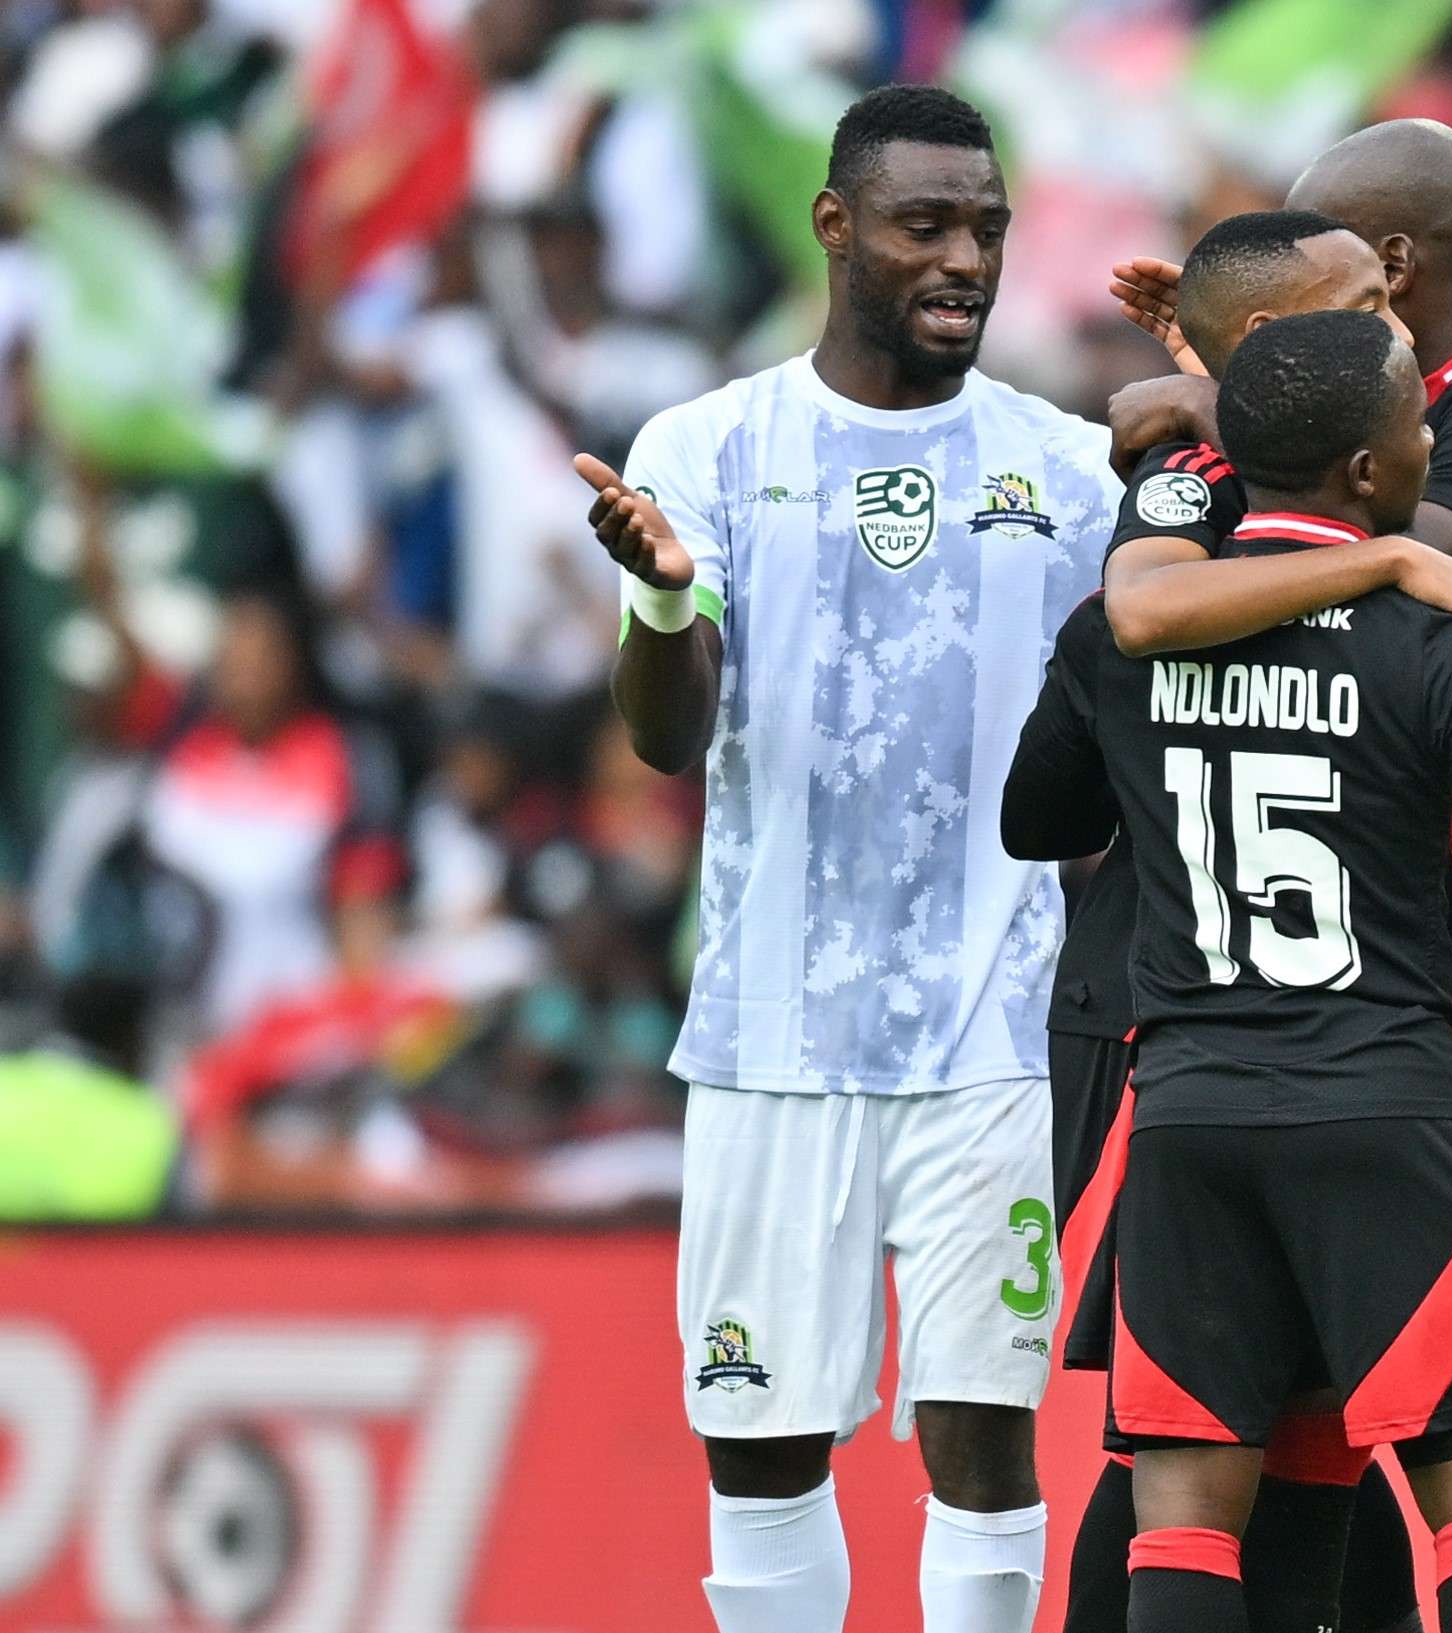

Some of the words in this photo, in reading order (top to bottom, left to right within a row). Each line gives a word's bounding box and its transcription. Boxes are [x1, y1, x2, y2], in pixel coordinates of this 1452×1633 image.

[866, 522, 926, 533] NEDBANK
[875, 534, 917, 551] CUP
[1151, 660, 1359, 737] NDLONDLO
[1165, 747, 1362, 991] 15
[1001, 1198, 1055, 1321] 3
